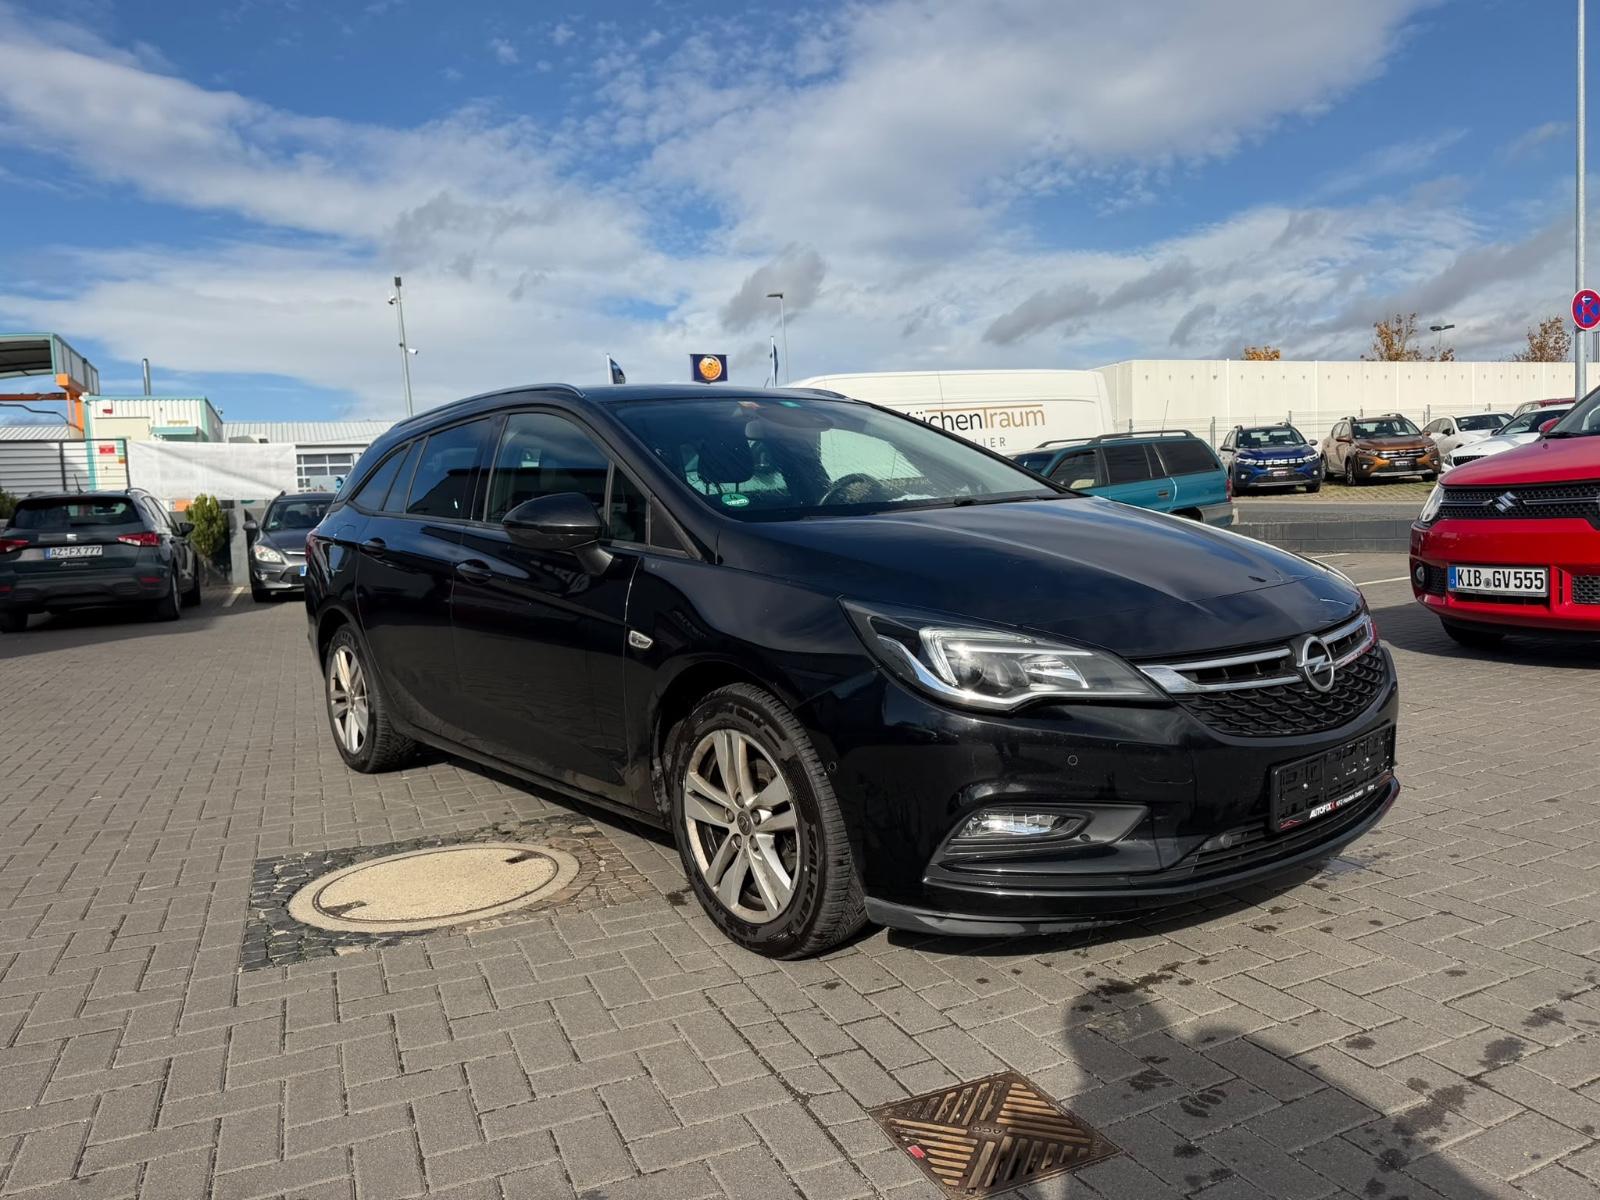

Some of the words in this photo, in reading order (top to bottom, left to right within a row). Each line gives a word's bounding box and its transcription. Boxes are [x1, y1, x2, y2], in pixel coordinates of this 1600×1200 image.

[906, 404, 1045, 432] chenTraum
[1456, 568, 1482, 588] KIB
[1492, 570, 1511, 589] GV
[1513, 571, 1545, 590] 555
